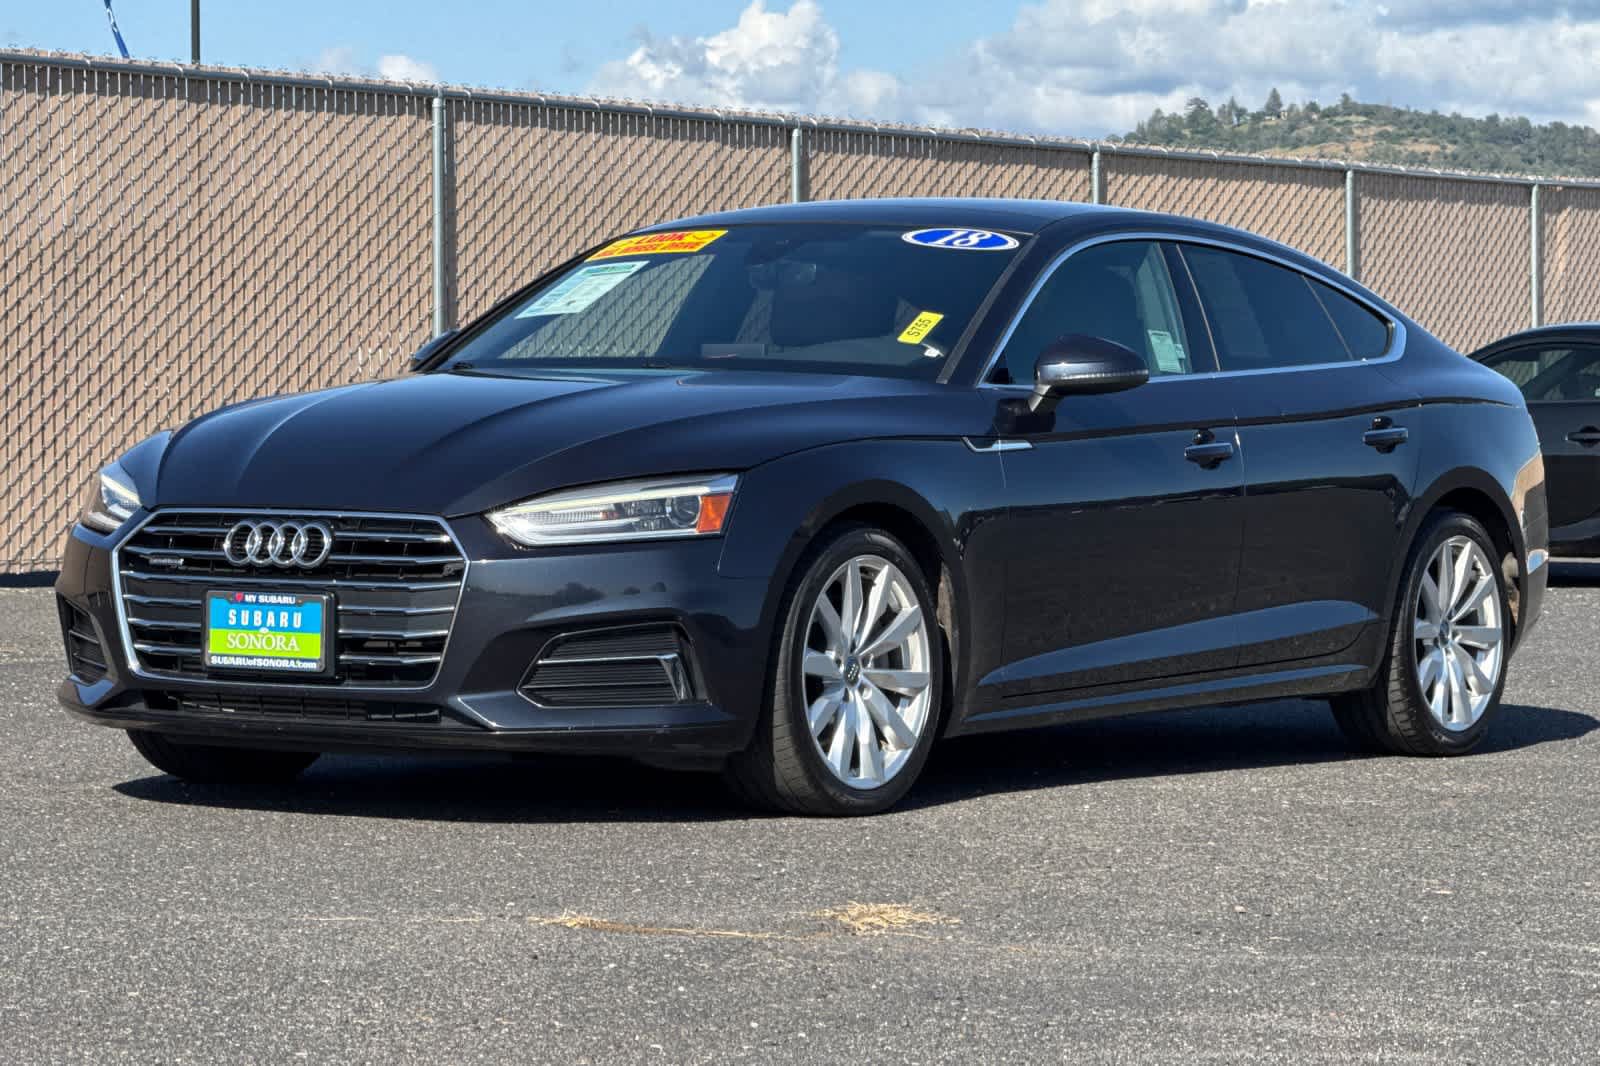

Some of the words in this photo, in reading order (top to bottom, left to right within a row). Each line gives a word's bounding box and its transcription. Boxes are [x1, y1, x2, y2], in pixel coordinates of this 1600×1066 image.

[927, 230, 993, 247] 18
[906, 318, 932, 337] S755
[244, 594, 257, 603] MY
[259, 595, 296, 604] SUBARU
[228, 608, 302, 629] SUBARU
[226, 632, 300, 652] SONORA
